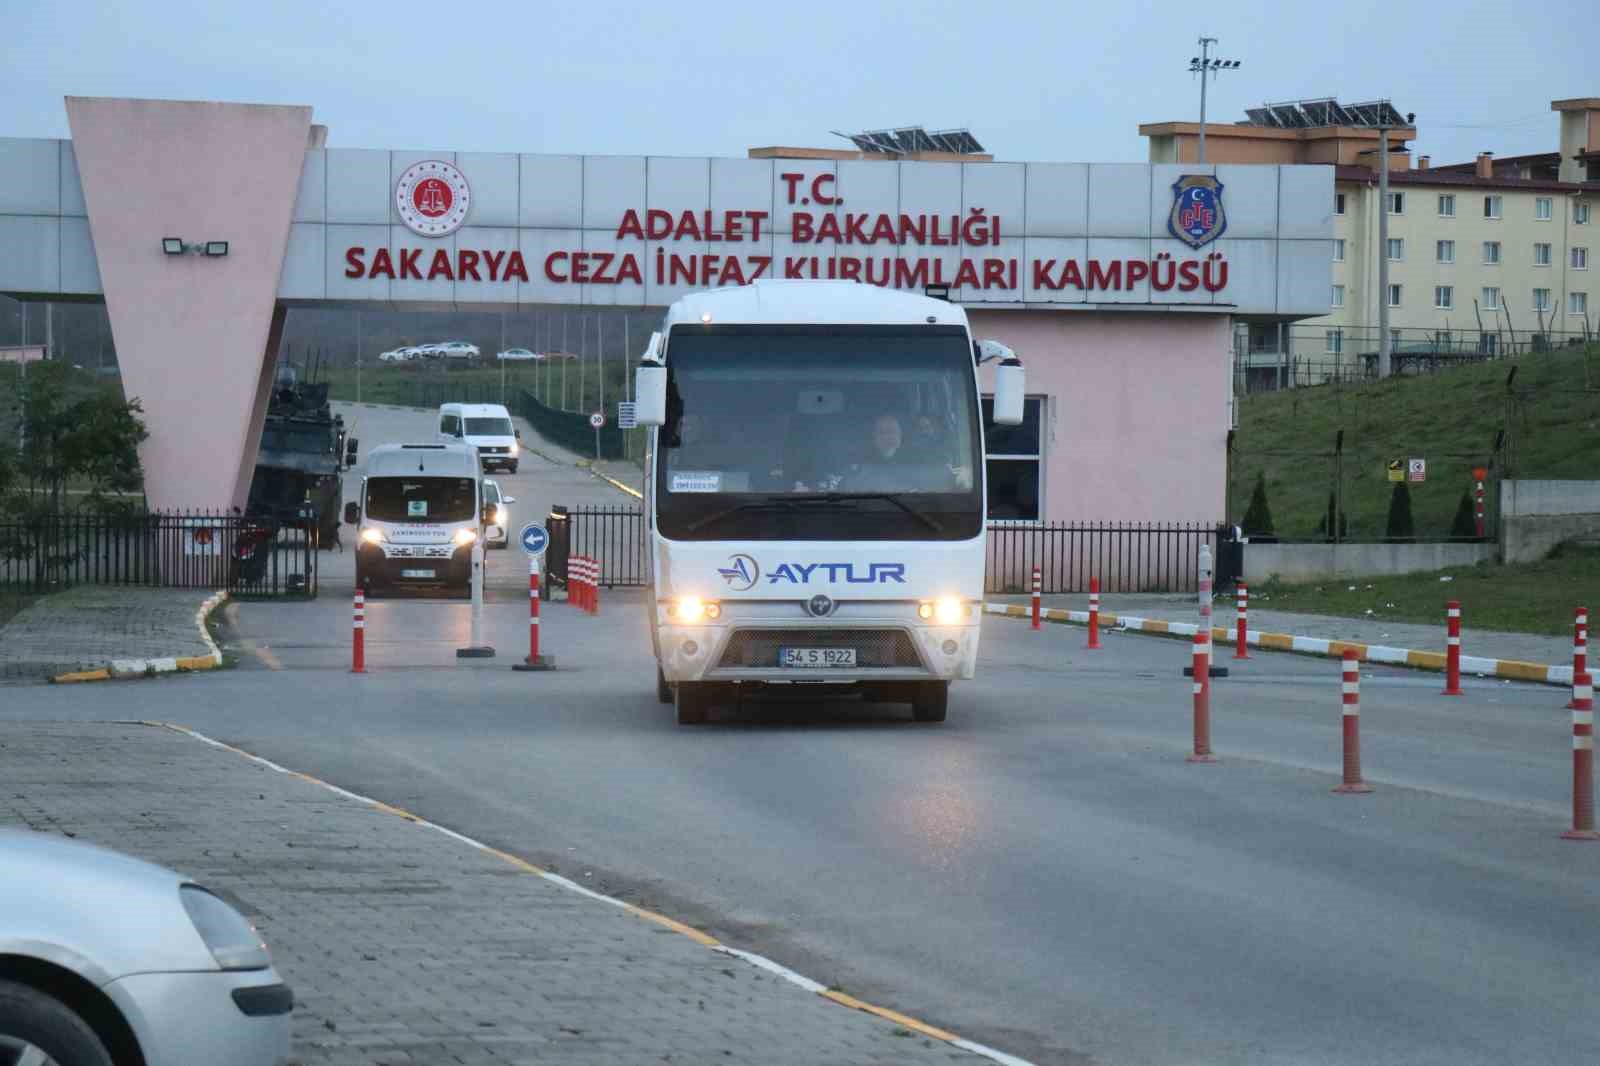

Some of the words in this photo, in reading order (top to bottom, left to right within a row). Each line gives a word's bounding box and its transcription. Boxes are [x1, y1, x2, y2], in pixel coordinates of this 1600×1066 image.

[781, 173, 844, 206] T.C.
[616, 209, 768, 242] ADALET
[791, 208, 1000, 247] BAKANLIĞI
[344, 247, 529, 283] SAKARYA
[544, 251, 642, 285] CEZA
[656, 246, 773, 287] İNFAZ
[784, 256, 1018, 290] KURUMLARI
[1033, 253, 1229, 293] KAMPÜSÜ
[766, 563, 907, 584] AYTUR
[785, 650, 803, 663] 54
[808, 650, 819, 663] S
[823, 649, 853, 664] 1922
